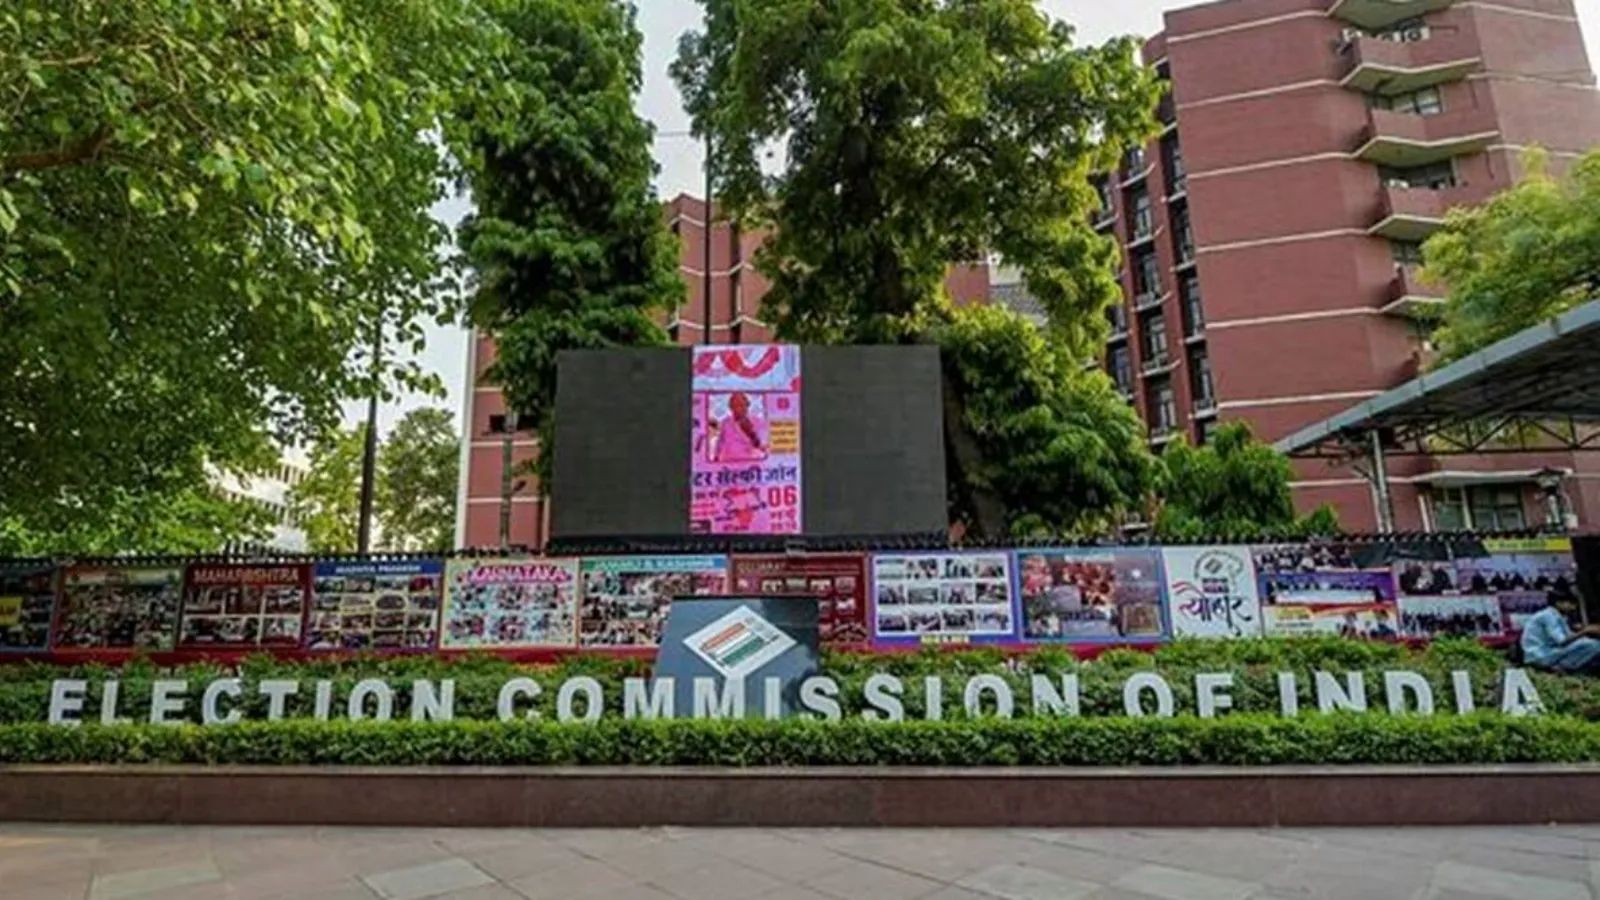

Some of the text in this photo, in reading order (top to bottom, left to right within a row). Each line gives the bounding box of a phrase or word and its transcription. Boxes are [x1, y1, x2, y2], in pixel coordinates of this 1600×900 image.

[768, 485, 797, 508] 06
[193, 566, 300, 584] MAHARASHTRA
[470, 563, 570, 583] KARNATAKA
[48, 667, 1548, 726] ELECTION COMMISSION OF INDIA
